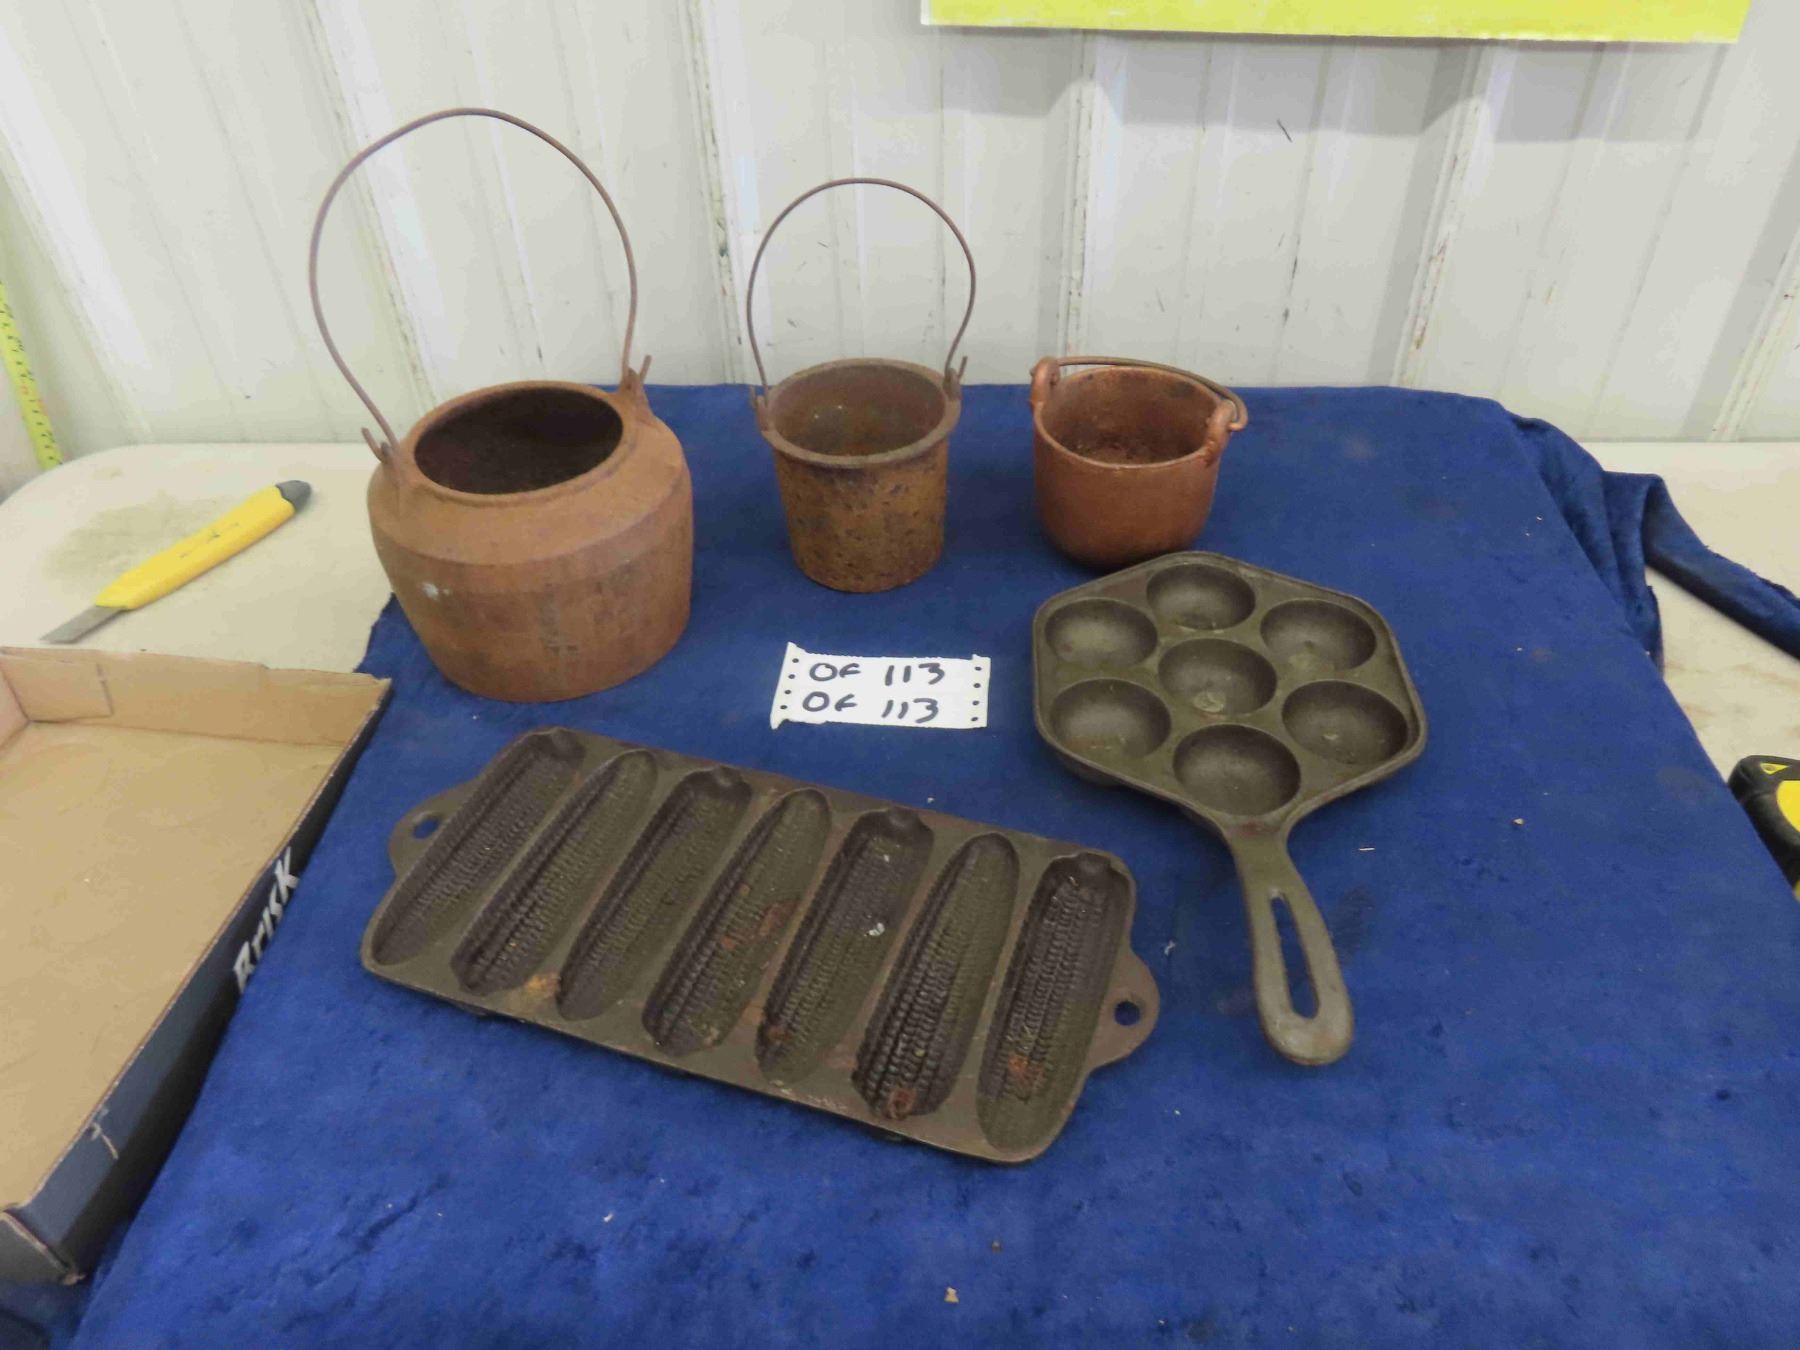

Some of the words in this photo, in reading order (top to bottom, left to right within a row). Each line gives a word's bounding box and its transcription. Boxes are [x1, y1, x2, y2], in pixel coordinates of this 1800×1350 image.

[809, 662, 861, 682] OF
[884, 662, 945, 687] 113
[881, 697, 939, 723] 113
